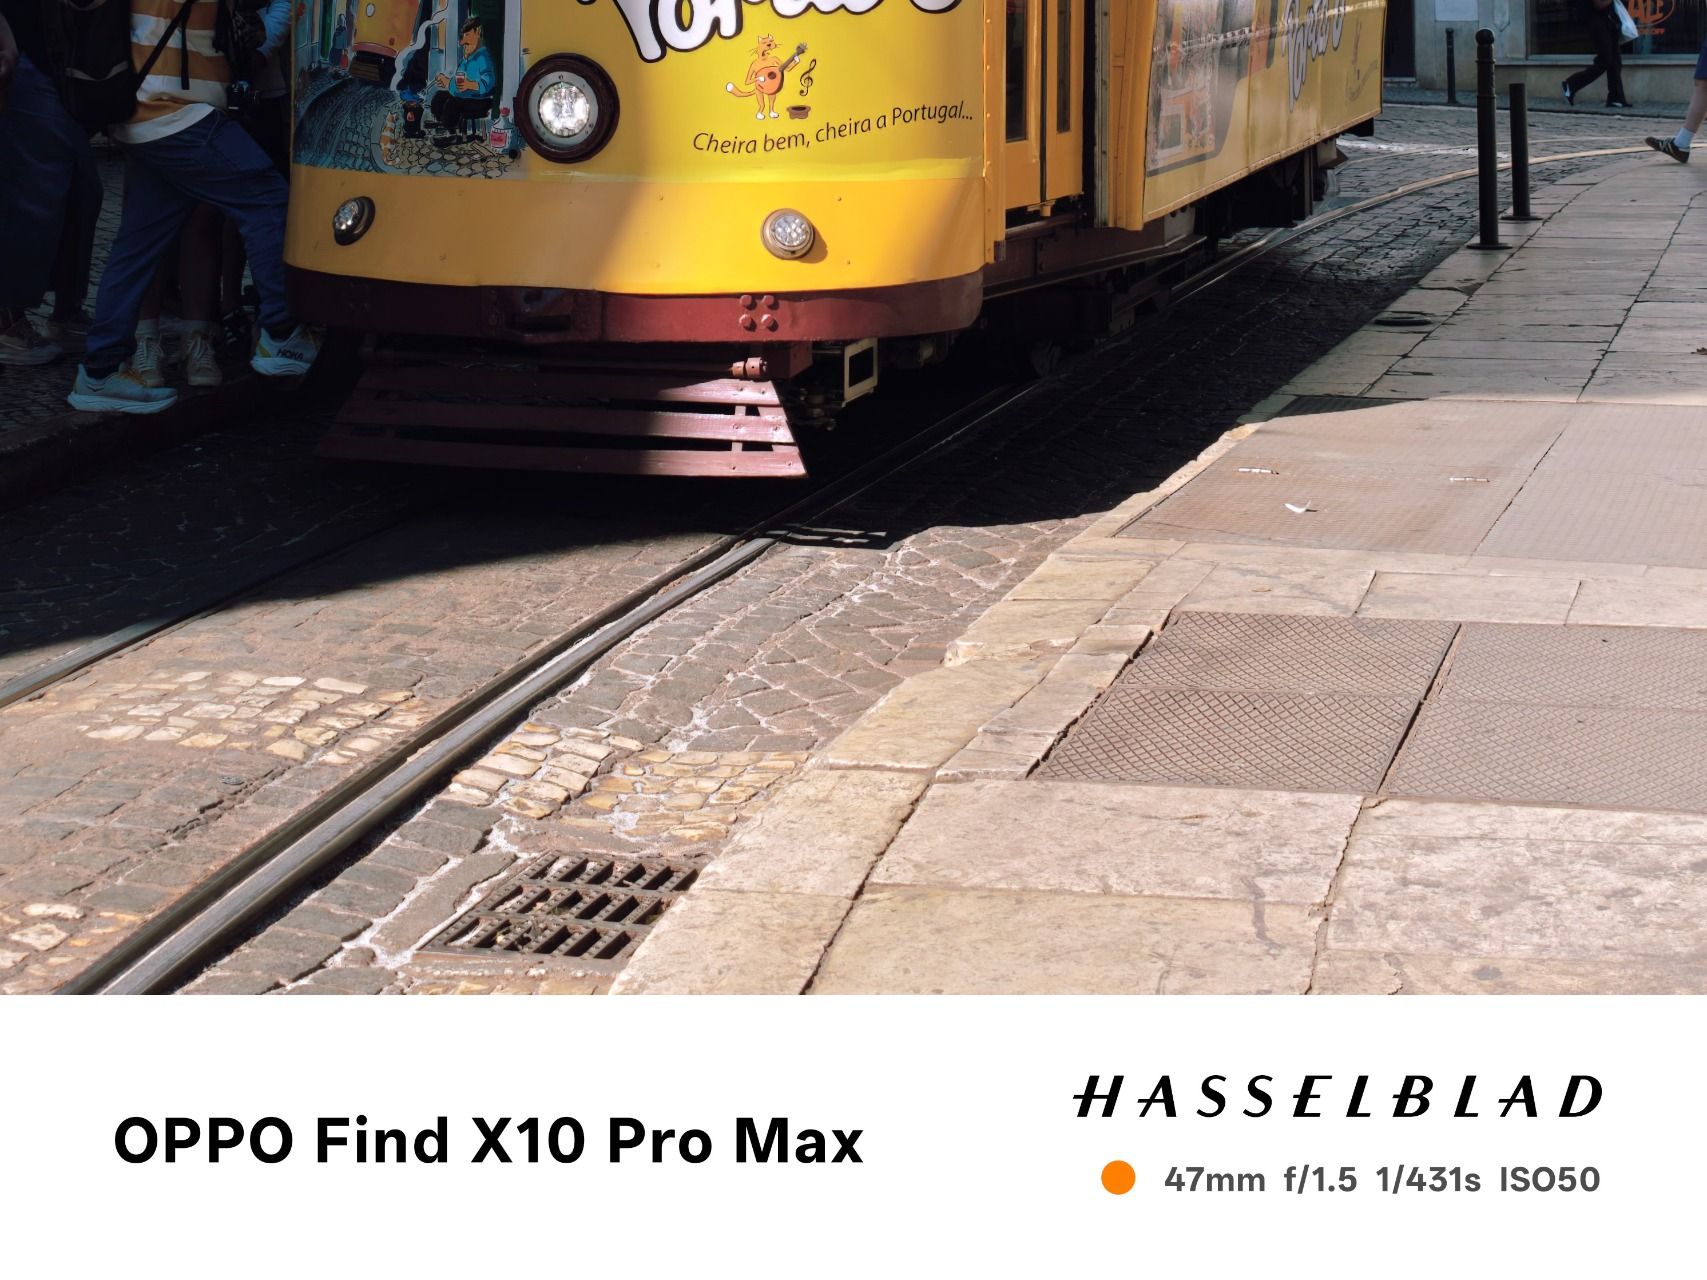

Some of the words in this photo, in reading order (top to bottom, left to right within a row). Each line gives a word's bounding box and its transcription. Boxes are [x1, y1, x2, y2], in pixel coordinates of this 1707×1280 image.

[693, 132, 757, 154] Cheira
[763, 130, 810, 152] bem,
[815, 119, 871, 143] cheira
[876, 113, 887, 129] a
[892, 101, 973, 125] Portugal...
